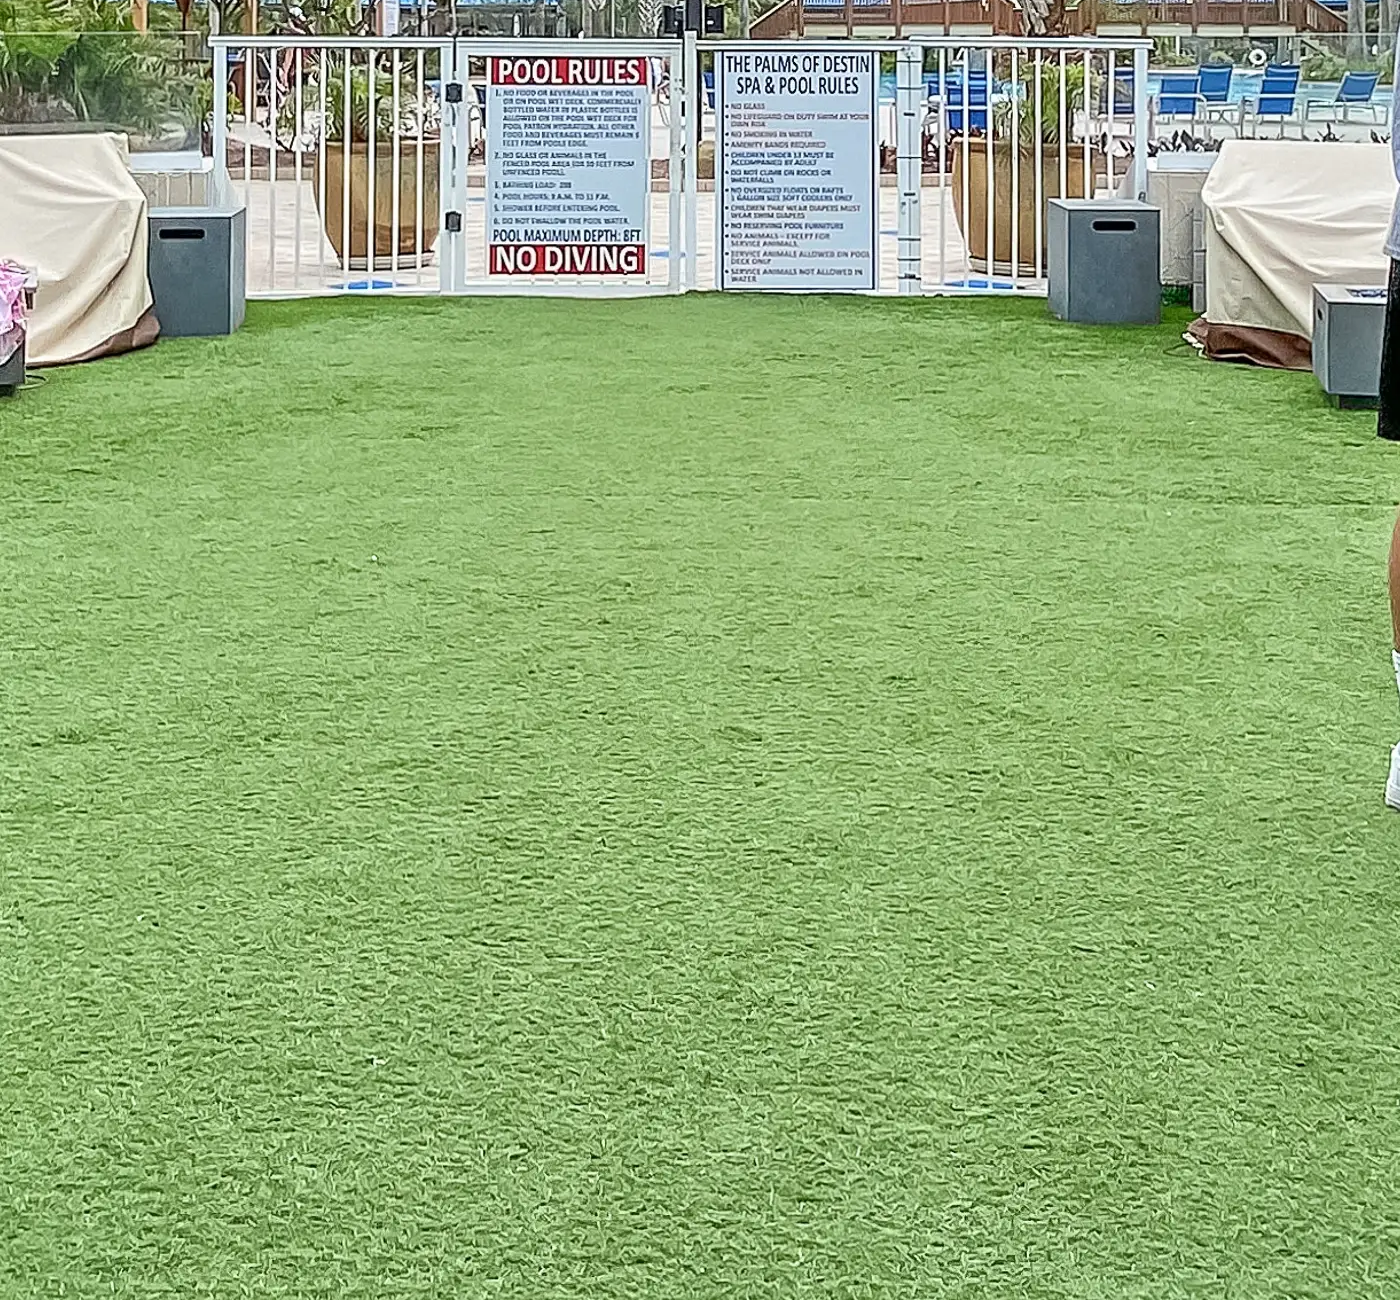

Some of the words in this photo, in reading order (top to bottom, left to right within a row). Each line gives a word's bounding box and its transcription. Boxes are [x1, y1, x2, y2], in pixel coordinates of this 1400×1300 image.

[499, 59, 563, 84] POOL
[568, 59, 639, 84] RULES
[726, 56, 750, 73] THE
[754, 56, 799, 73] PALMS
[803, 56, 820, 73] OF
[823, 56, 869, 73] DESTIN
[736, 77, 761, 95] SPA
[765, 77, 775, 95] &
[780, 77, 815, 95] POOL
[819, 77, 859, 95] RULES
[493, 229, 523, 242] POOL
[524, 229, 581, 242] MAXIMUM
[583, 229, 621, 242] DEPTH:
[623, 229, 641, 242] 8FT
[496, 246, 537, 272] NO
[544, 246, 638, 272] DIVING
